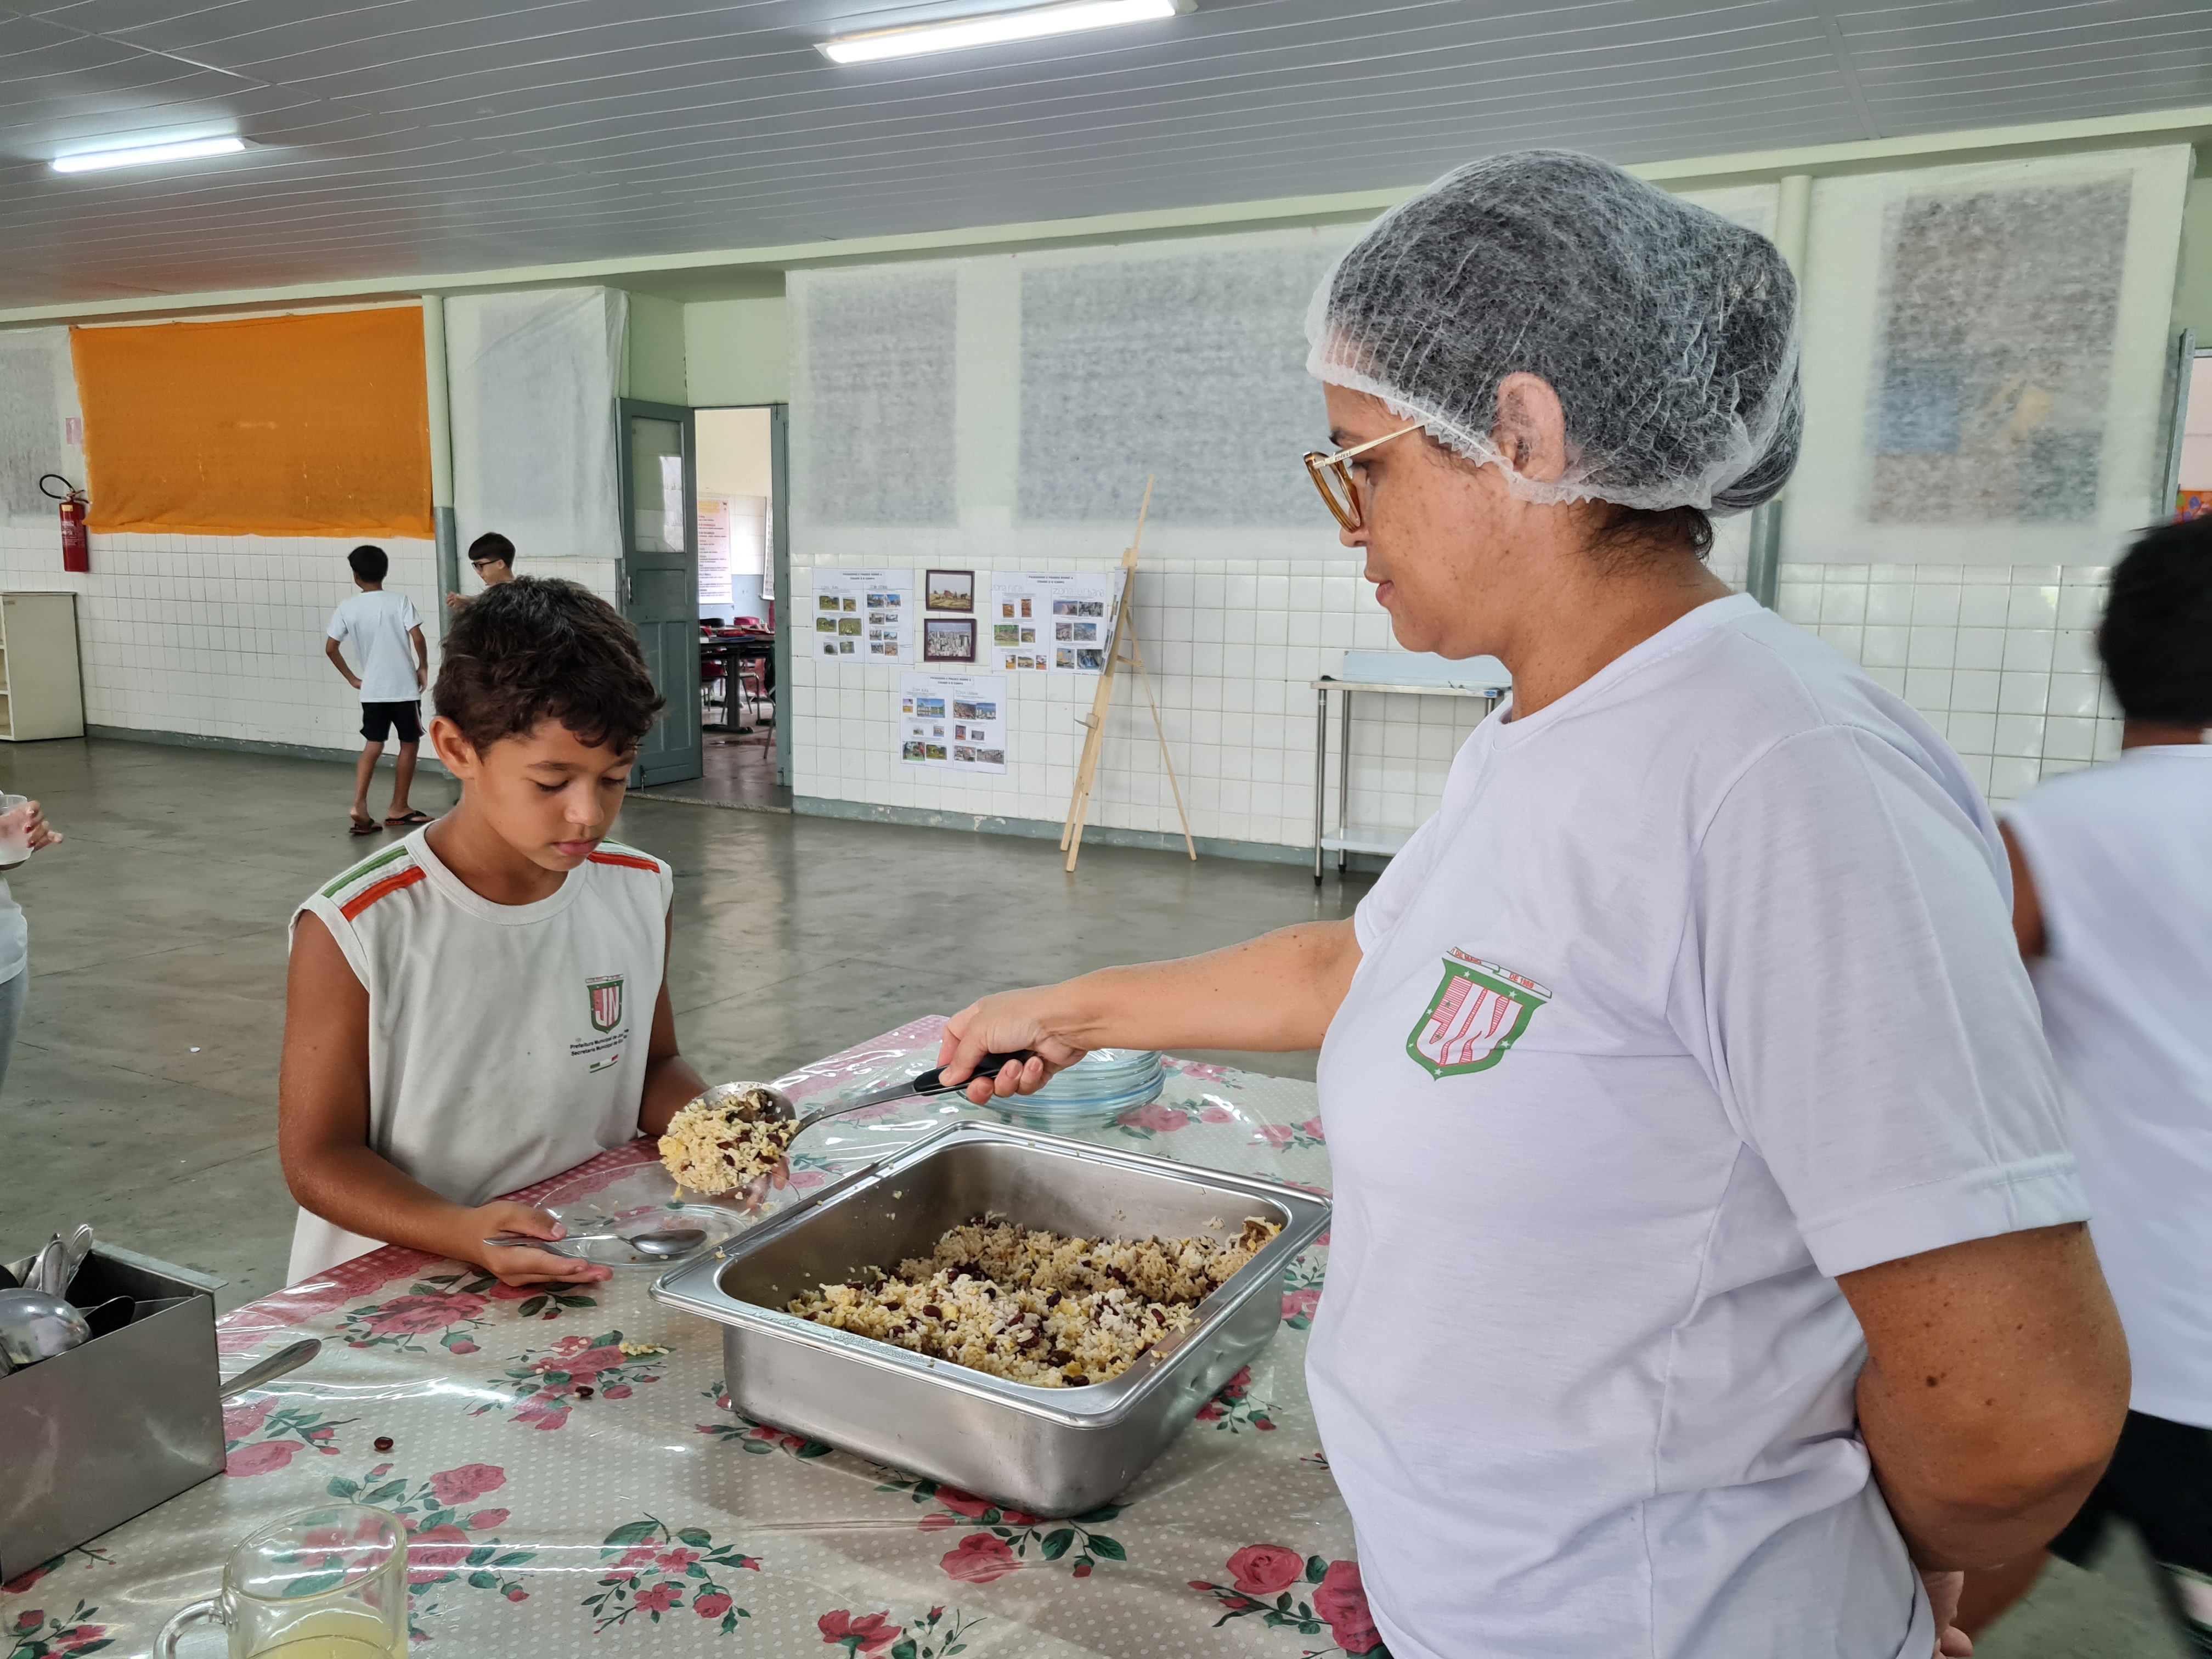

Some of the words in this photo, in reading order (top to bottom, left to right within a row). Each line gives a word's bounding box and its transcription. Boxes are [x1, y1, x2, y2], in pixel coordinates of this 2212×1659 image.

[1052, 587, 1074, 596] zona
[1077, 588, 1105, 597] urbana
[1455, 950, 1463, 958] DE
[1509, 973, 1519, 981] DE
[570, 1041, 594, 1049] Prefeitura
[594, 1036, 612, 1045] Municipal
[571, 1048, 596, 1056] Secretaria
